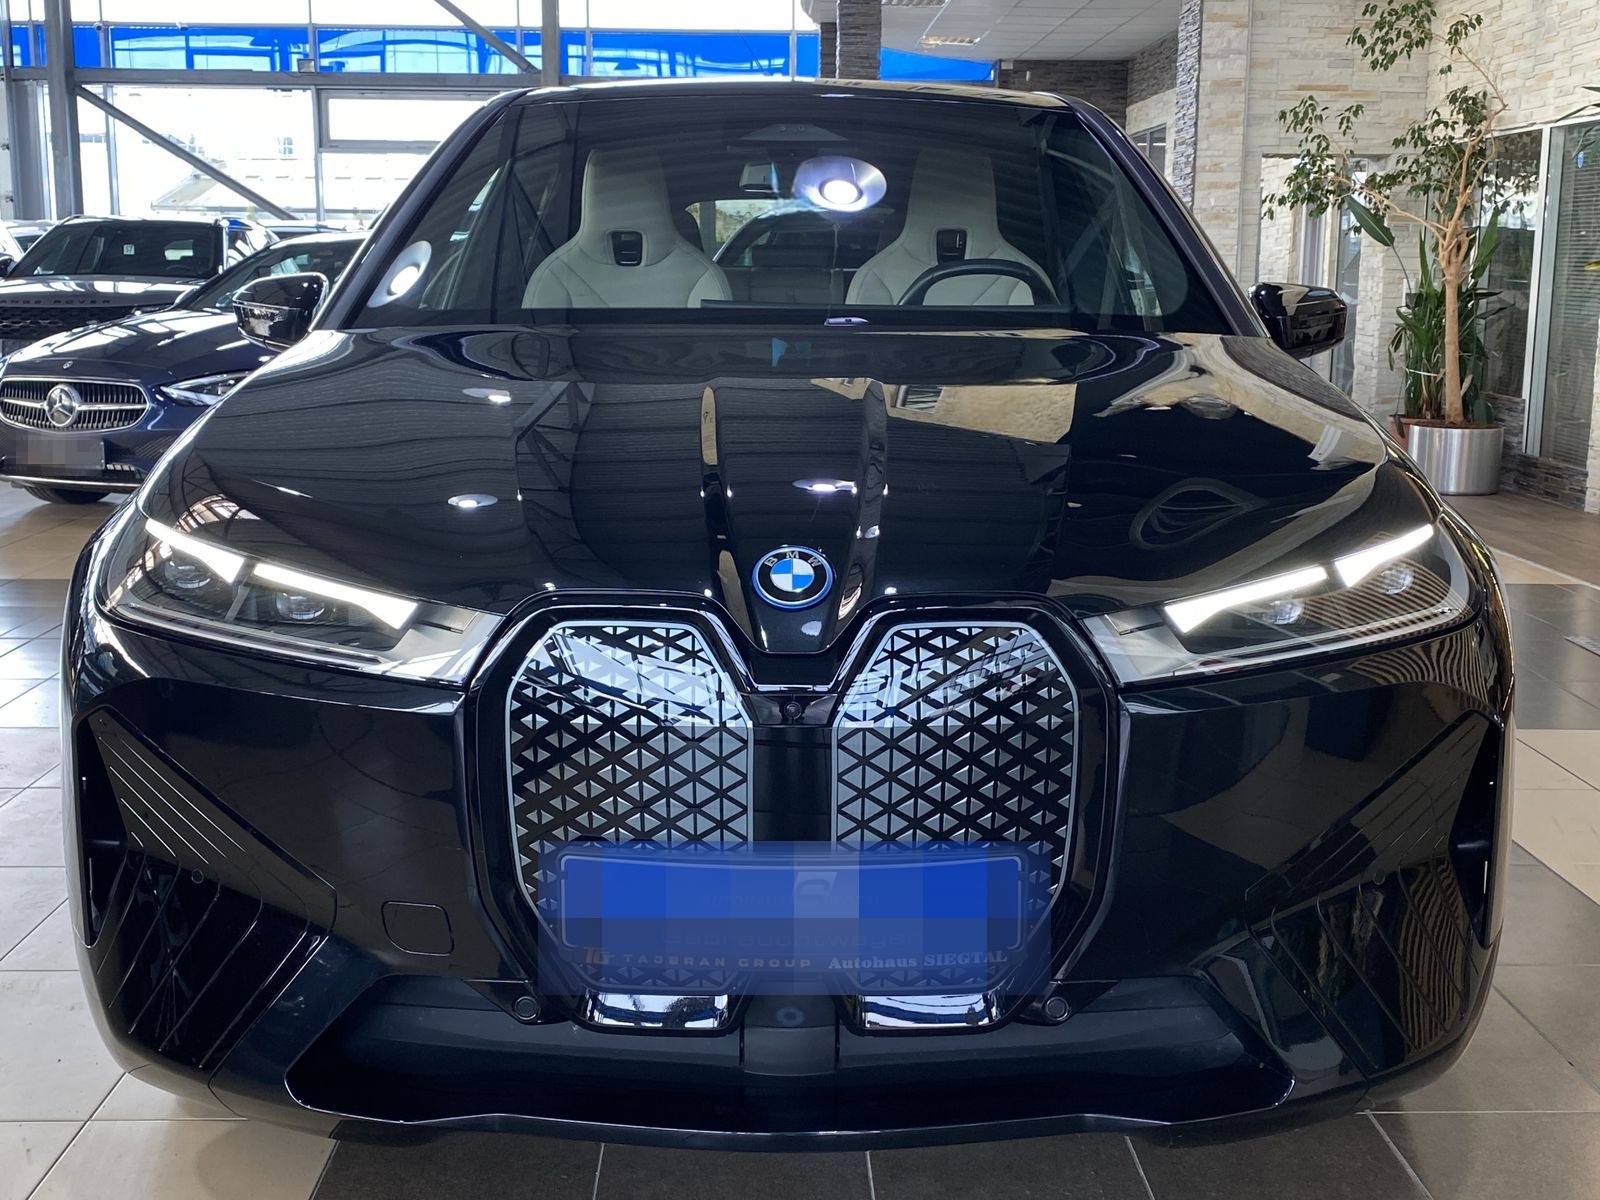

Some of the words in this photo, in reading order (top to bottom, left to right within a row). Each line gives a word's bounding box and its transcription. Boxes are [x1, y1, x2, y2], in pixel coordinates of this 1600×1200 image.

[764, 551, 821, 566] BMW
[660, 926, 924, 949] Gebrauchtwagen
[623, 953, 727, 967] TAJERAN
[737, 957, 812, 969] GROUP
[828, 955, 918, 970] Autohaus
[922, 950, 1008, 967] SIEGTAL
